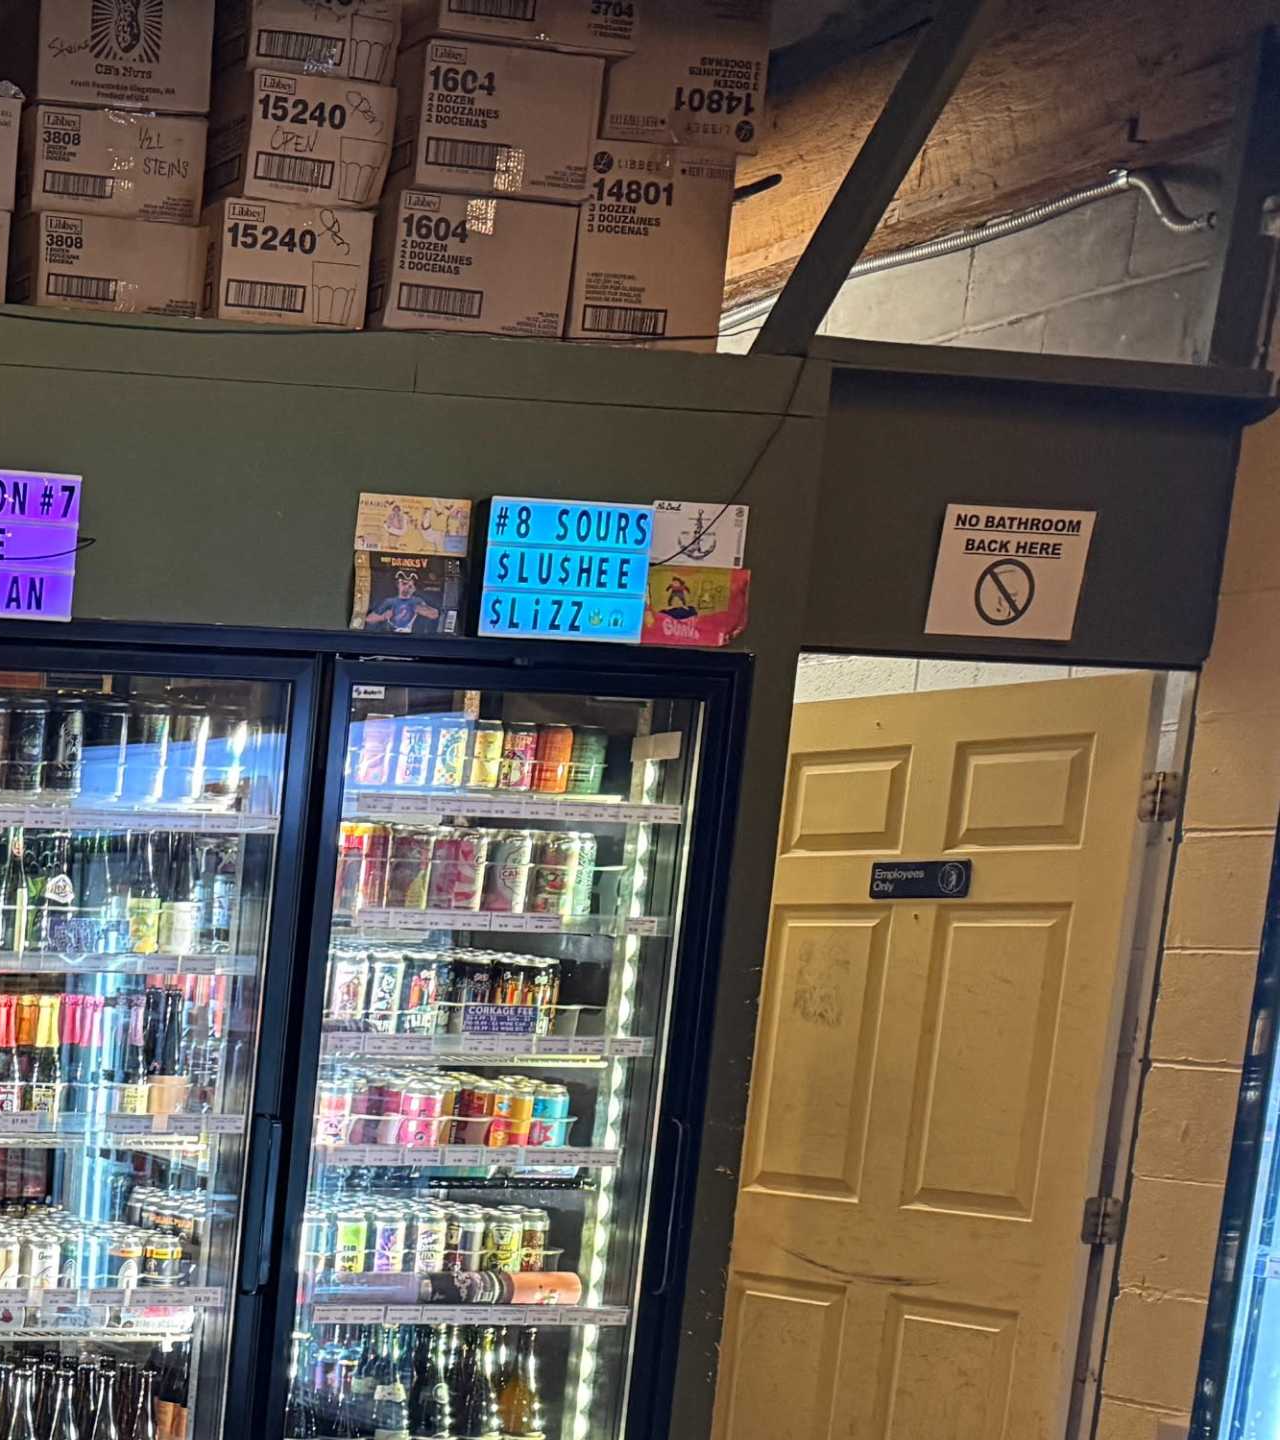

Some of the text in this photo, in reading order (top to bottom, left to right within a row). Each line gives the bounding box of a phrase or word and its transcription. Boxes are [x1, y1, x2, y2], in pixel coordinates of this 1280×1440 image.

[434, 49, 465, 62] Libbey
[262, 78, 294, 92] Libbey
[429, 67, 497, 97] 1604
[712, 78, 750, 90] DOZEN
[437, 94, 476, 105] DOZEN
[674, 87, 755, 116] 14801
[258, 94, 347, 131] 15240
[437, 105, 500, 119] DOUZAINES
[46, 115, 79, 128] Libbey
[437, 115, 488, 129] DOCENAS
[43, 131, 81, 146] 3808
[270, 126, 319, 152] OPEN
[143, 158, 189, 178] STEINS
[592, 178, 674, 207] 14801
[407, 195, 438, 209] Libbey
[231, 206, 262, 220] Libbey
[597, 204, 637, 215] DOZEN
[48, 217, 80, 233] Libbey
[597, 214, 661, 228] DOUZAINES
[402, 215, 469, 244] 1604
[597, 224, 649, 237] DOCENAS
[46, 234, 83, 249] 3808
[227, 222, 317, 255] 15240
[410, 240, 448, 252] DOZEN
[409, 250, 473, 266] DOUZAINES
[409, 261, 461, 276] DOCENAS
[555, 508, 649, 547] SOURS
[955, 513, 1082, 533] NO BATHROOM
[964, 538, 1062, 556] BACK HERE
[874, 868, 924, 880] Employees
[873, 881, 895, 892] Only
[468, 1006, 534, 1015] CORKAGE FEE
